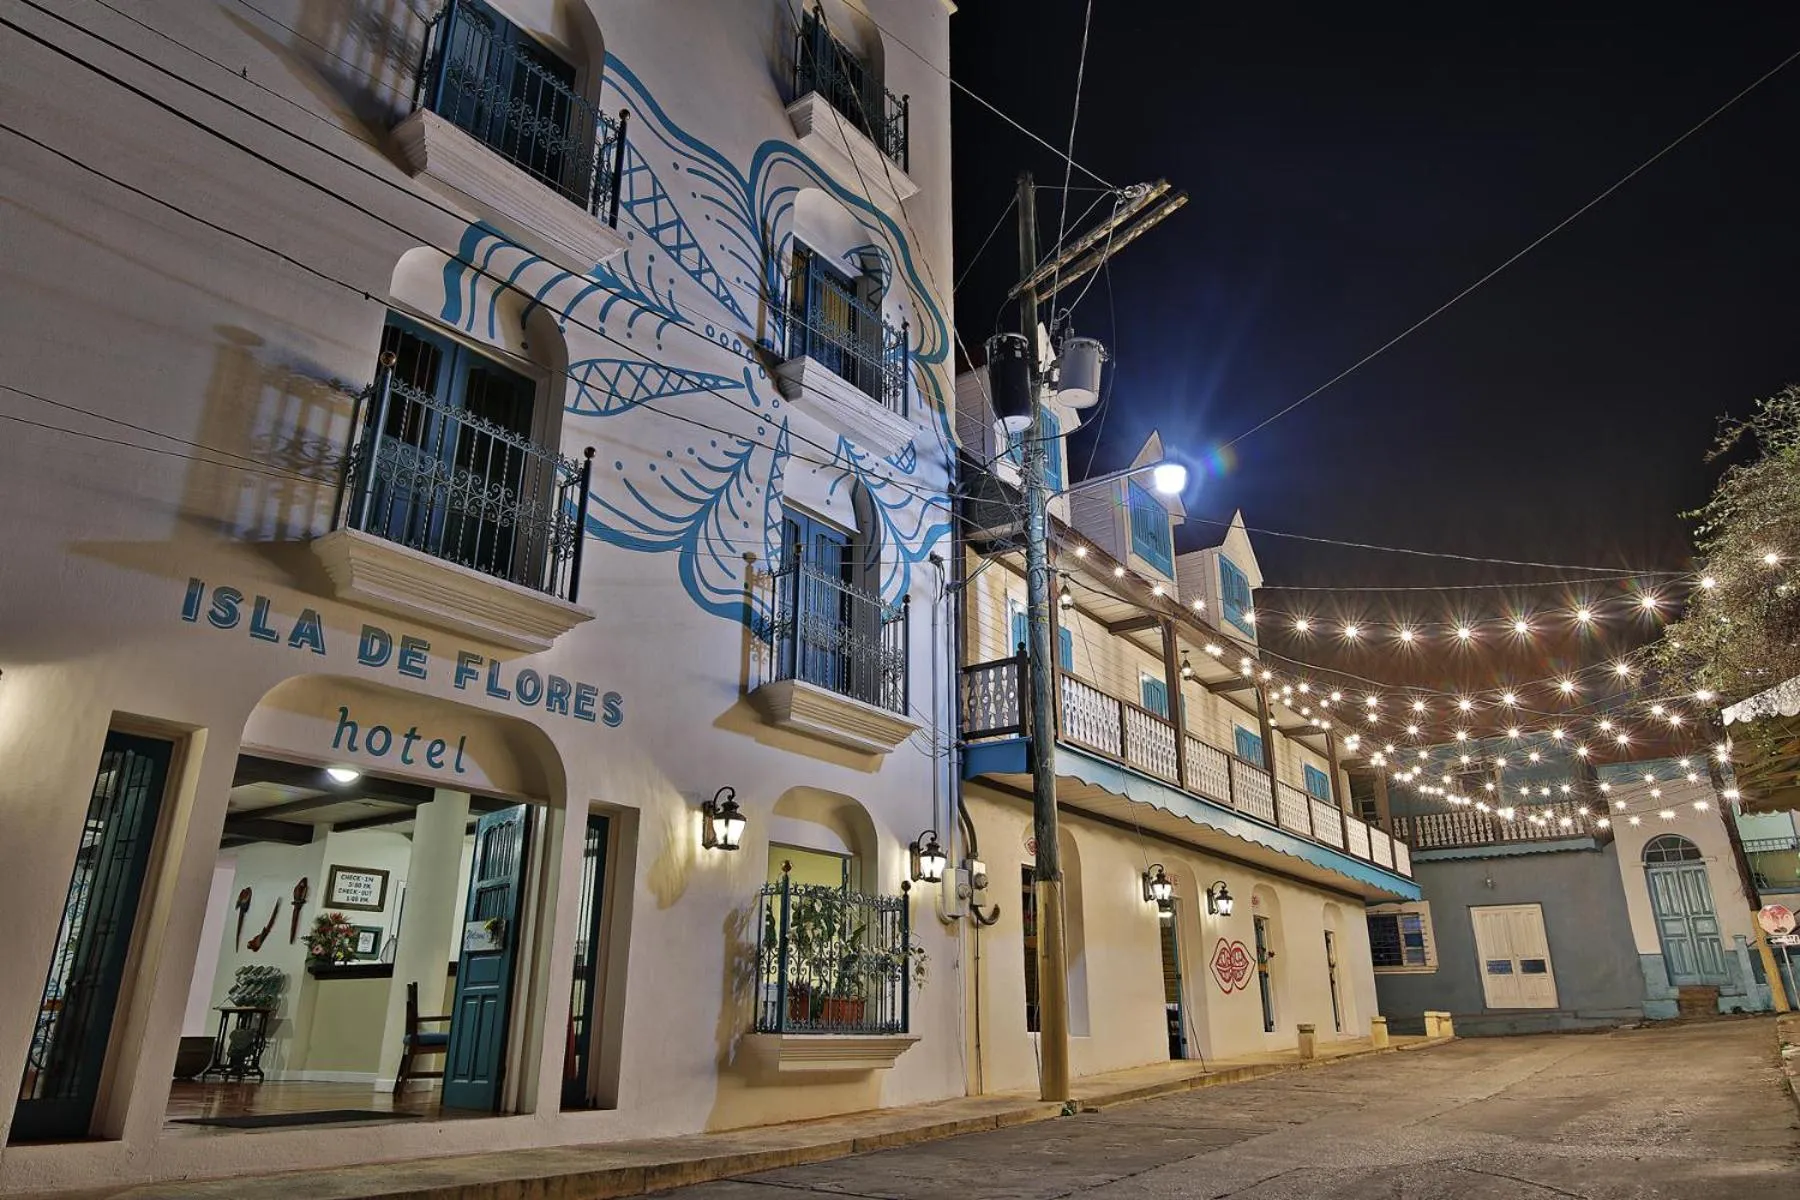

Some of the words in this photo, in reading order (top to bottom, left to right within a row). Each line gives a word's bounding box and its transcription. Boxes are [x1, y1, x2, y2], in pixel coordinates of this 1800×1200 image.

[182, 577, 326, 655] ISLA
[357, 623, 430, 680] DE
[453, 650, 624, 728] FLORES
[332, 706, 466, 773] hotel
